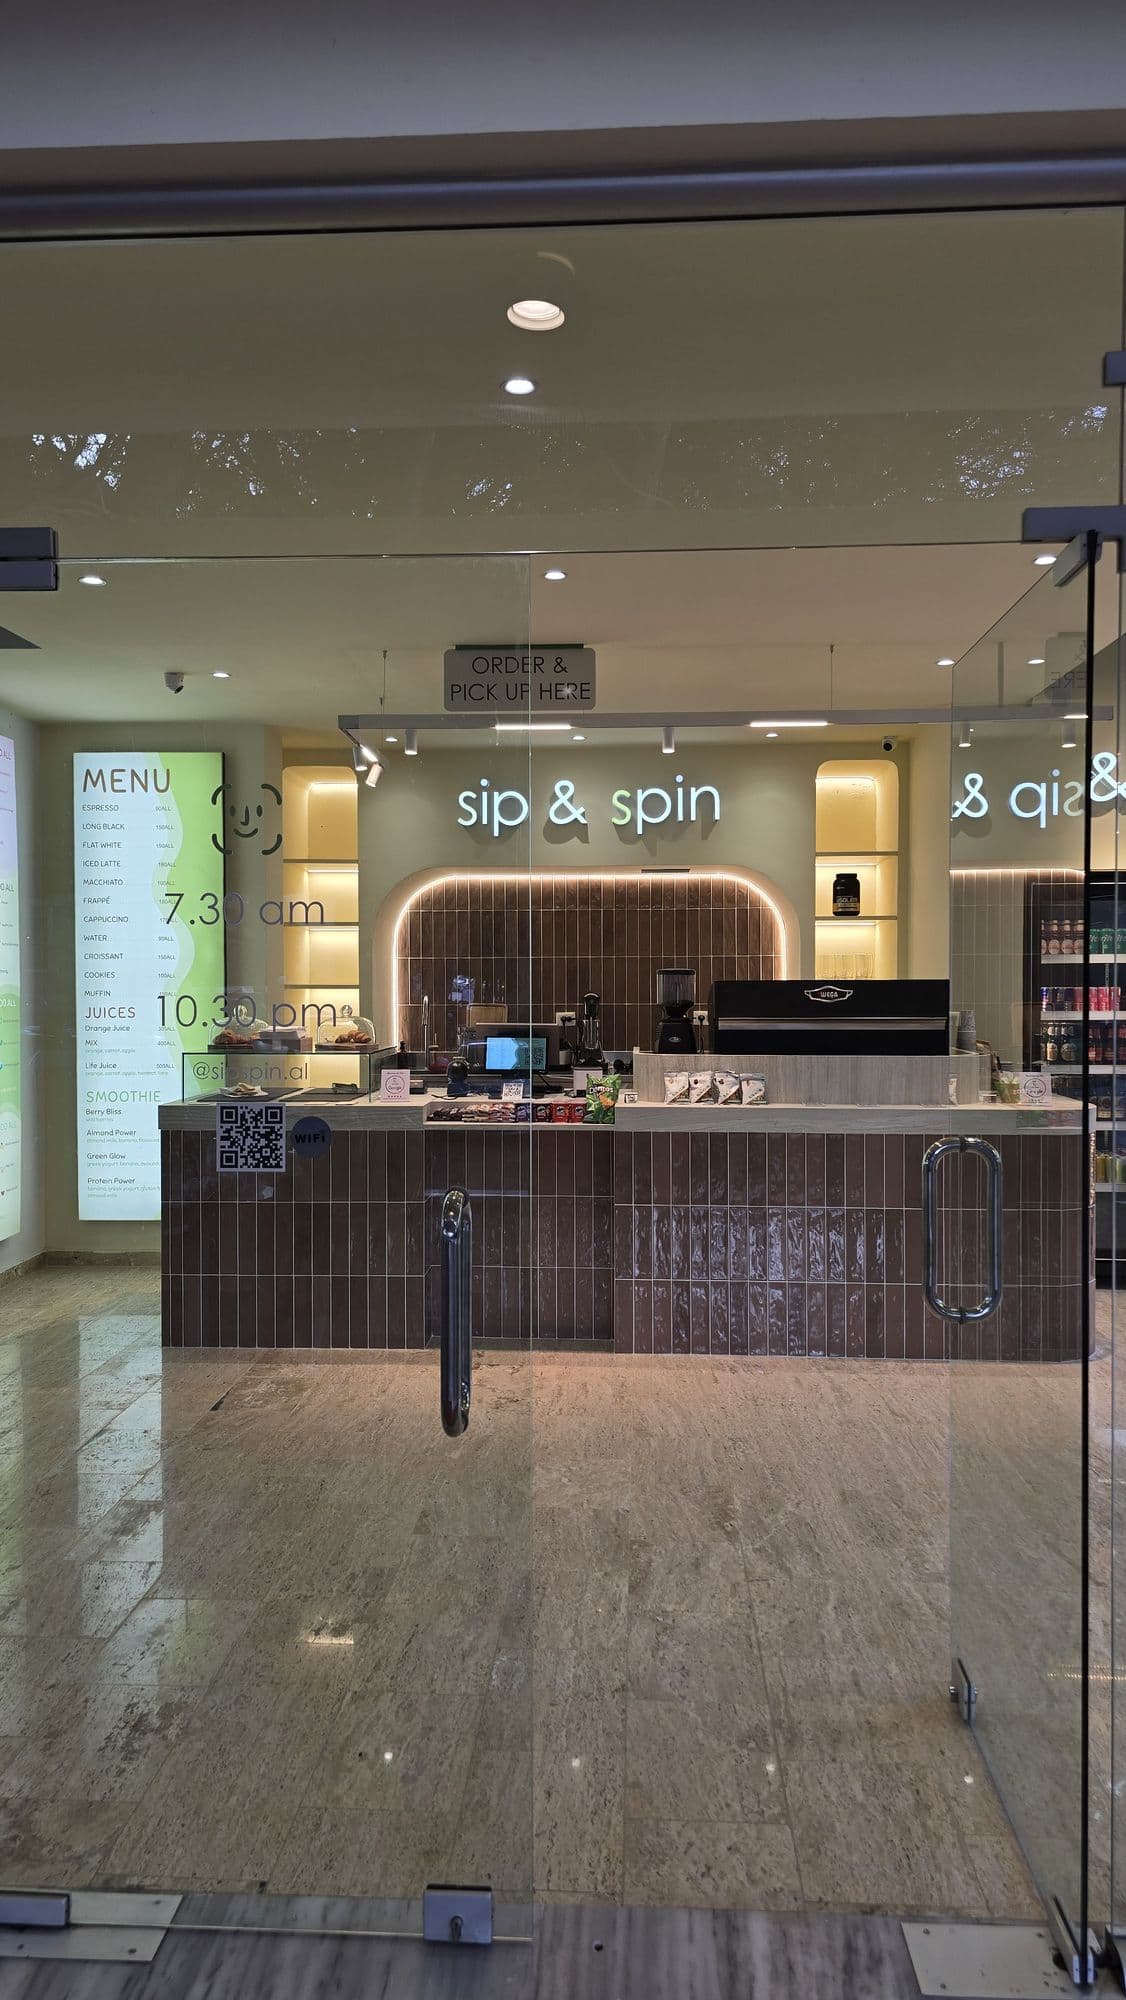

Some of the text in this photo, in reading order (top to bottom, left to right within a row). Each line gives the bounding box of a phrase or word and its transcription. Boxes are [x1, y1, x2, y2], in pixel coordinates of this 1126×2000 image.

[472, 656, 568, 674] ORDER &
[451, 682, 591, 701] PICK UP HERE
[82, 768, 170, 793] MENU
[82, 804, 119, 812] ESPRESSO
[457, 774, 720, 836] sip & spin
[83, 896, 111, 905] FRAPPÉ
[164, 892, 324, 926] 7.30 am
[85, 1007, 136, 1019] JUICES
[157, 994, 337, 1037] 10.30 pm
[84, 1025, 111, 1033] Orange
[86, 1090, 161, 1103] SMOOTHIE
[86, 1108, 105, 1116] Berry
[86, 1129, 114, 1137] Almond
[109, 1152, 126, 1160] Glow
[87, 1177, 113, 1185] Protein
